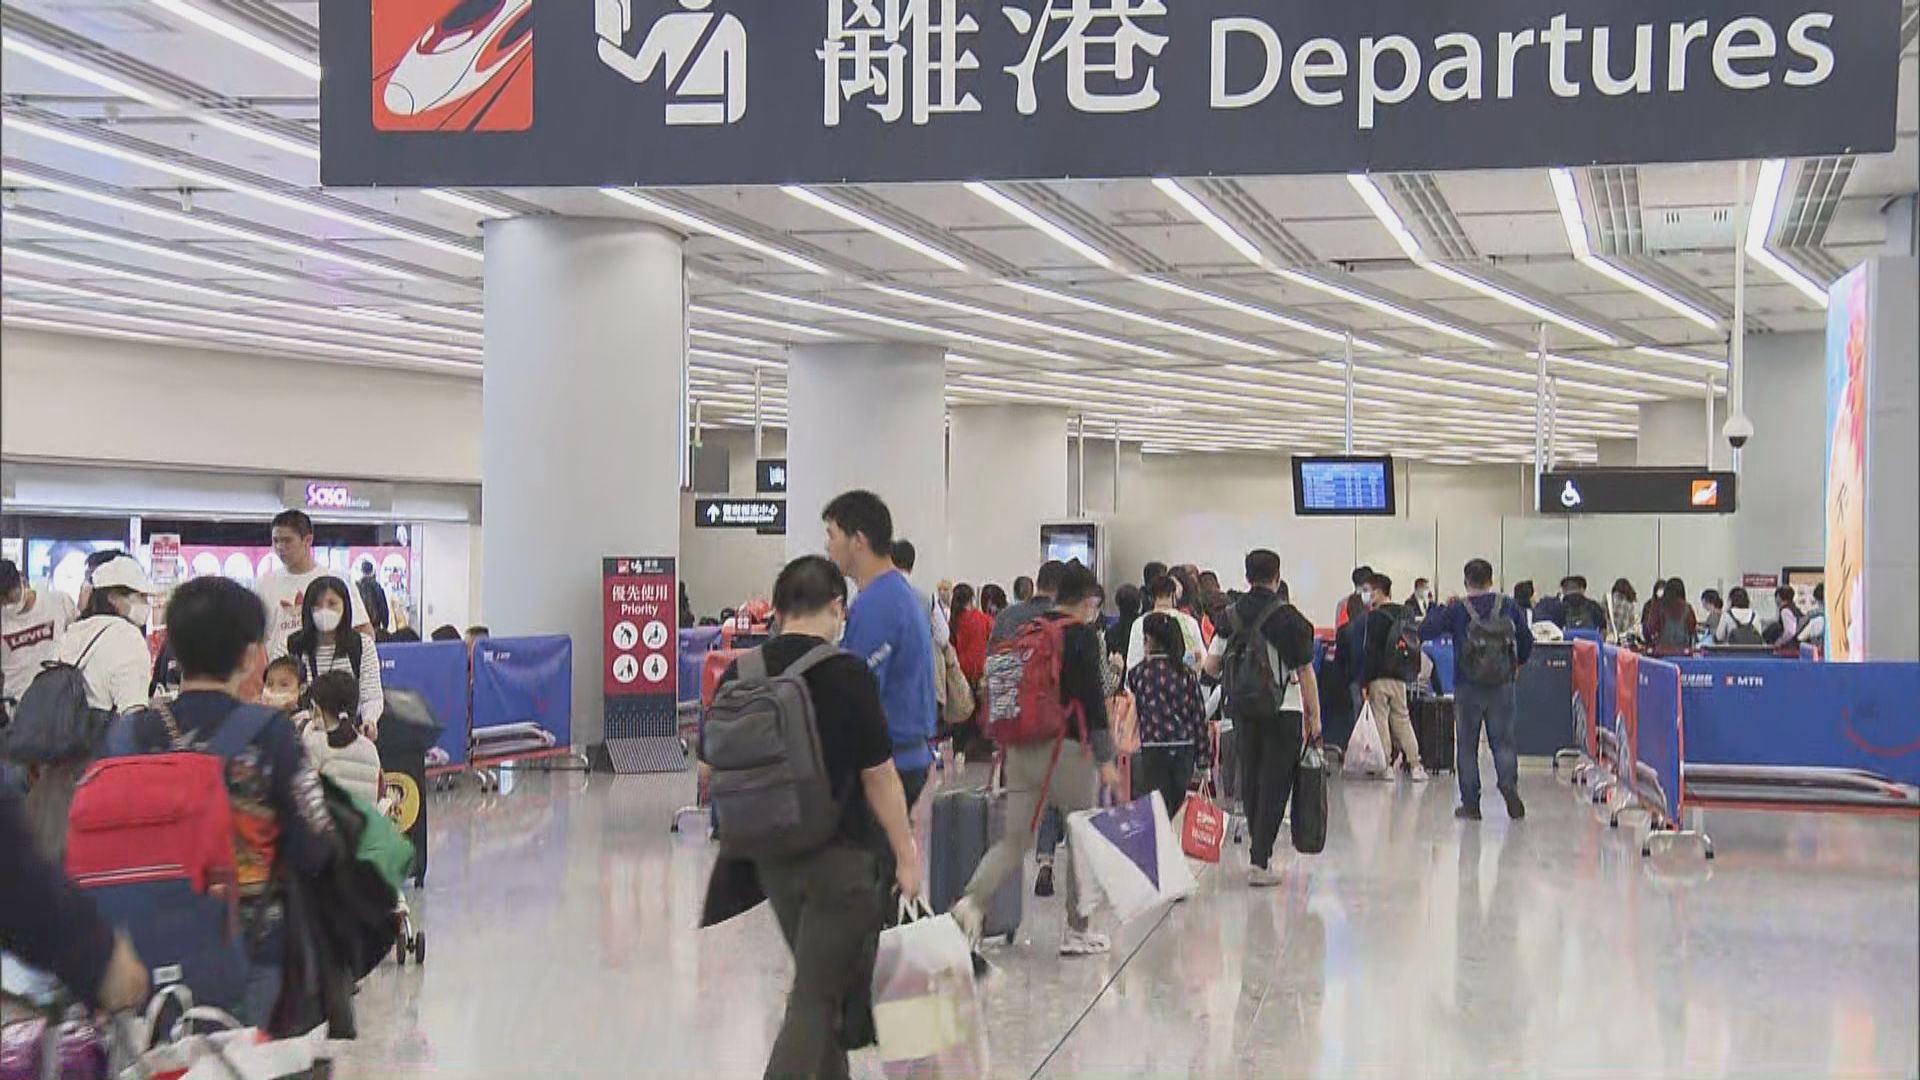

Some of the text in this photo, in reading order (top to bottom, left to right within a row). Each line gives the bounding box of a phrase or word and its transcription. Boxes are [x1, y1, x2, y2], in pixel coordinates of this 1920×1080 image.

[815, 0, 1836, 130] 離港 Departures
[612, 584, 668, 602] 優先使用
[620, 603, 658, 617] Priority
[1737, 675, 1764, 687] MTR
